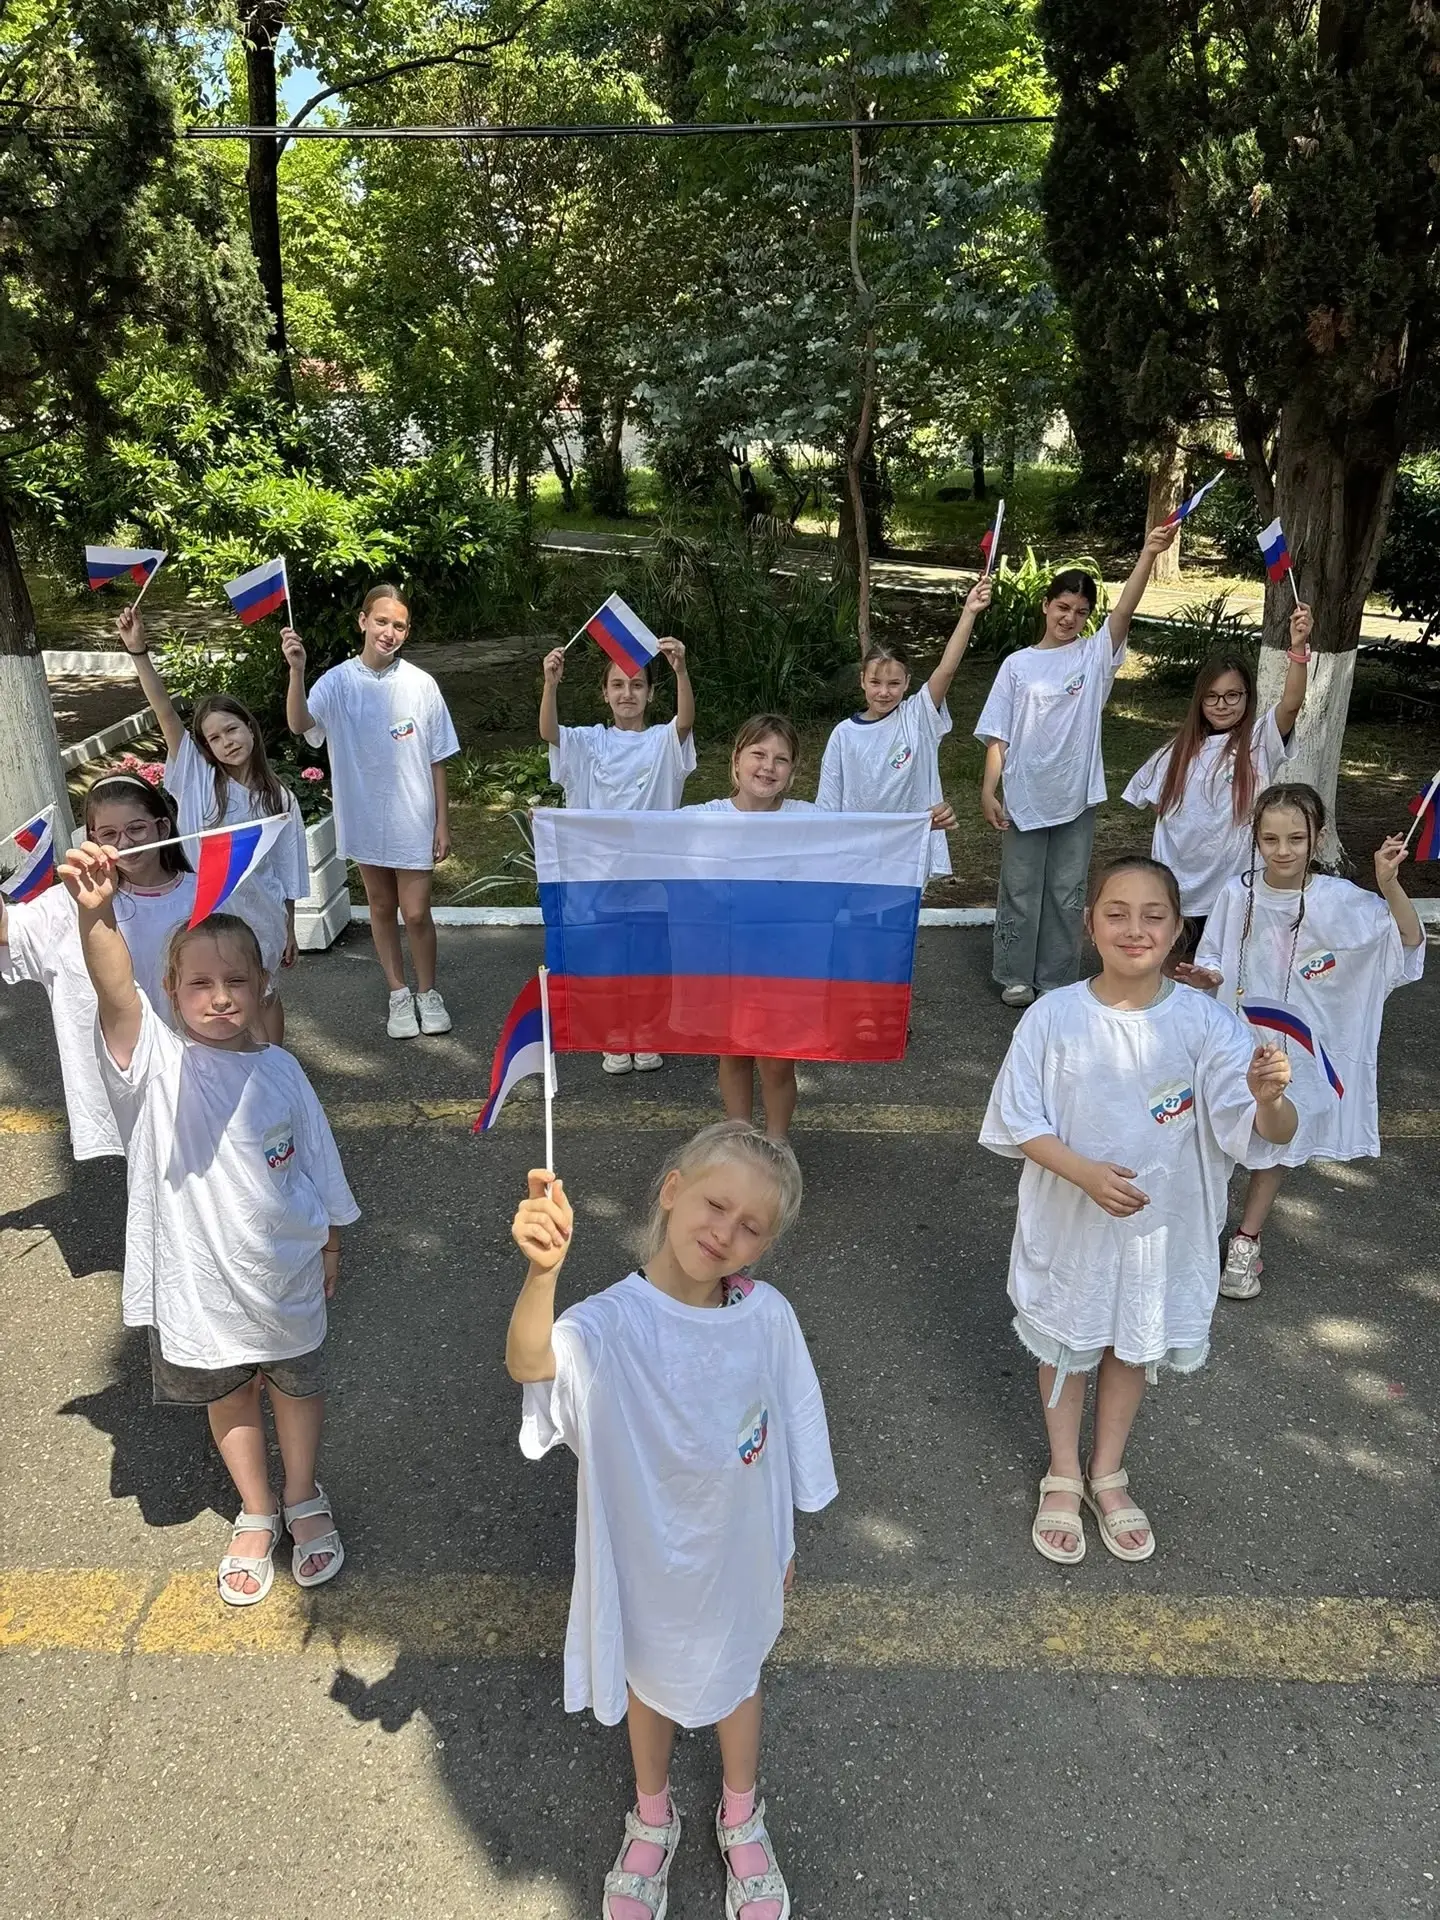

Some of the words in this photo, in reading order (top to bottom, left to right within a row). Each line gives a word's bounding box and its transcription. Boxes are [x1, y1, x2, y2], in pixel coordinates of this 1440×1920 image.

[1310, 959, 1322, 969] 27
[1165, 1097, 1180, 1108] 27
[278, 1142, 289, 1153] 27
[753, 1427, 762, 1442] 2
